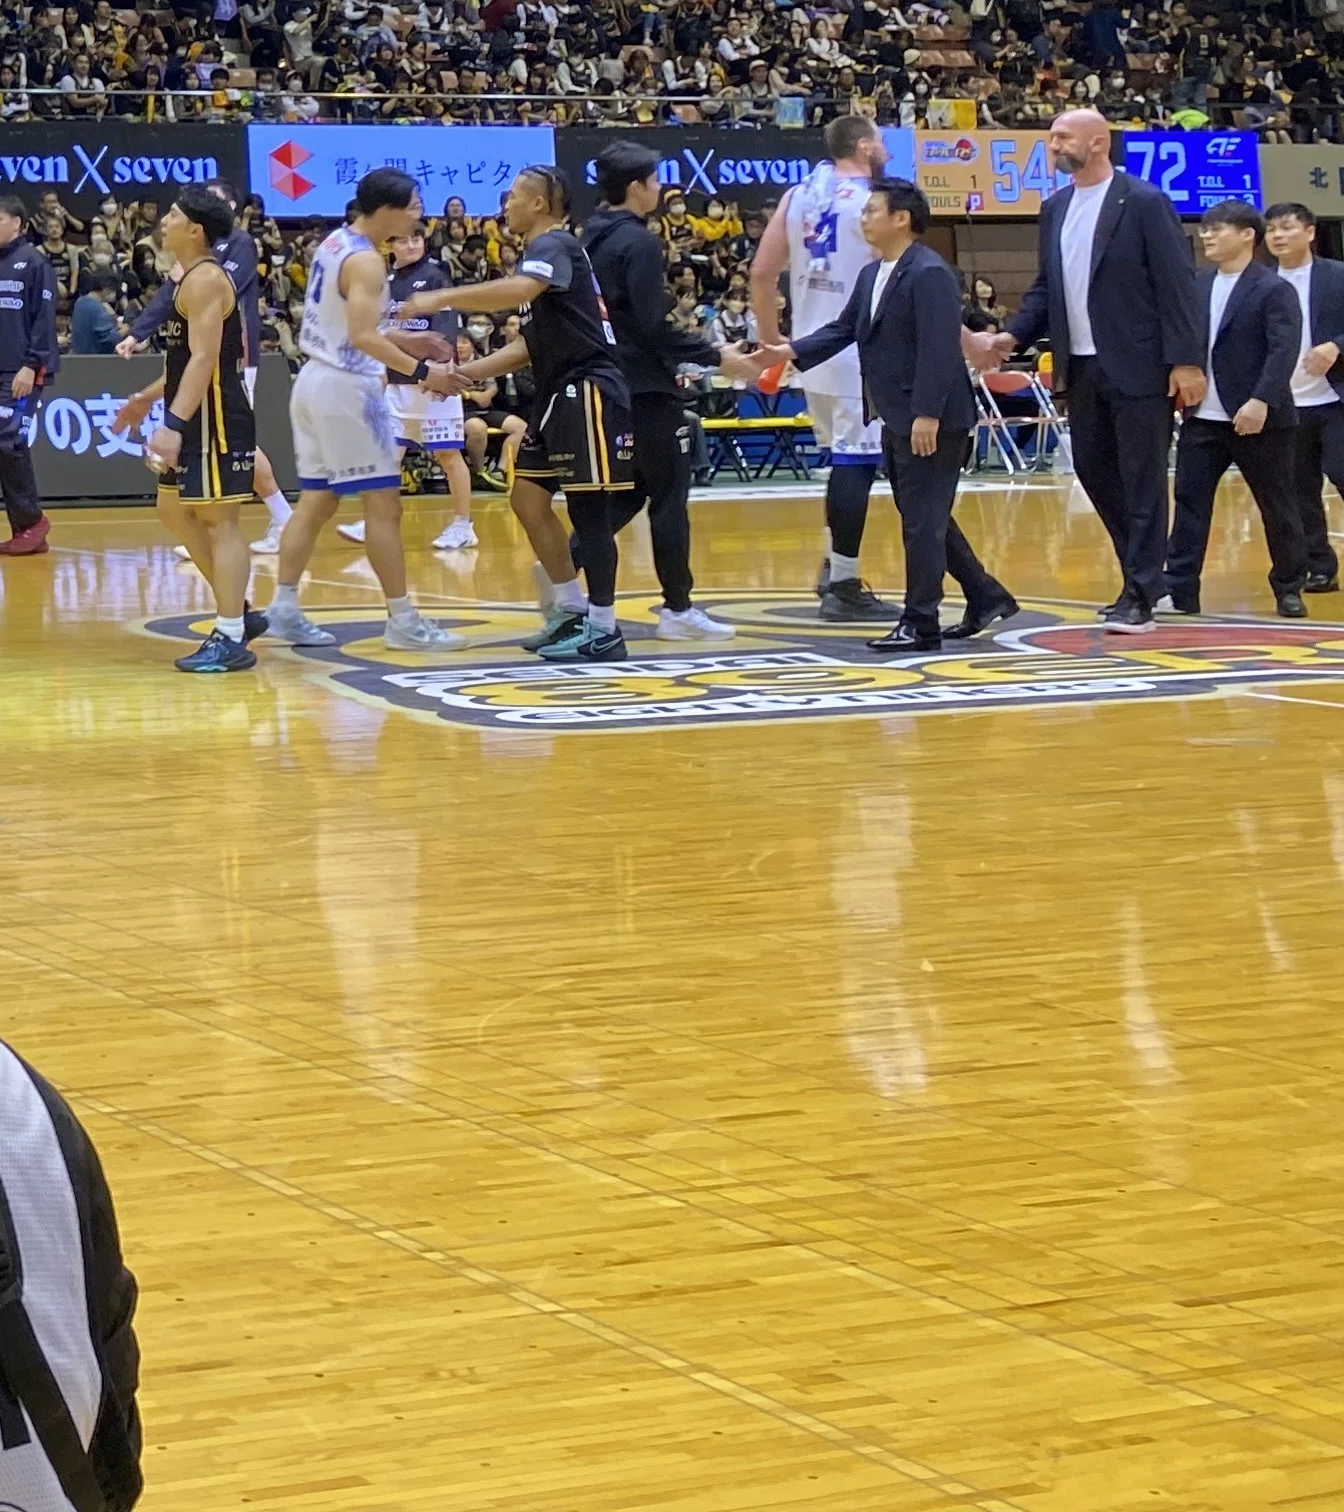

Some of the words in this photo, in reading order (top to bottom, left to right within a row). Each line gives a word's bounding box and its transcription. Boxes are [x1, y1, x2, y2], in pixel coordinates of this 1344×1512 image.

[113, 151, 218, 185] seven
[719, 157, 810, 187] seven
[970, 174, 978, 189] 1
[990, 139, 1053, 204] 54
[1126, 141, 1190, 202] 72
[1243, 174, 1252, 189] 1
[458, 640, 1344, 706] 89ER
